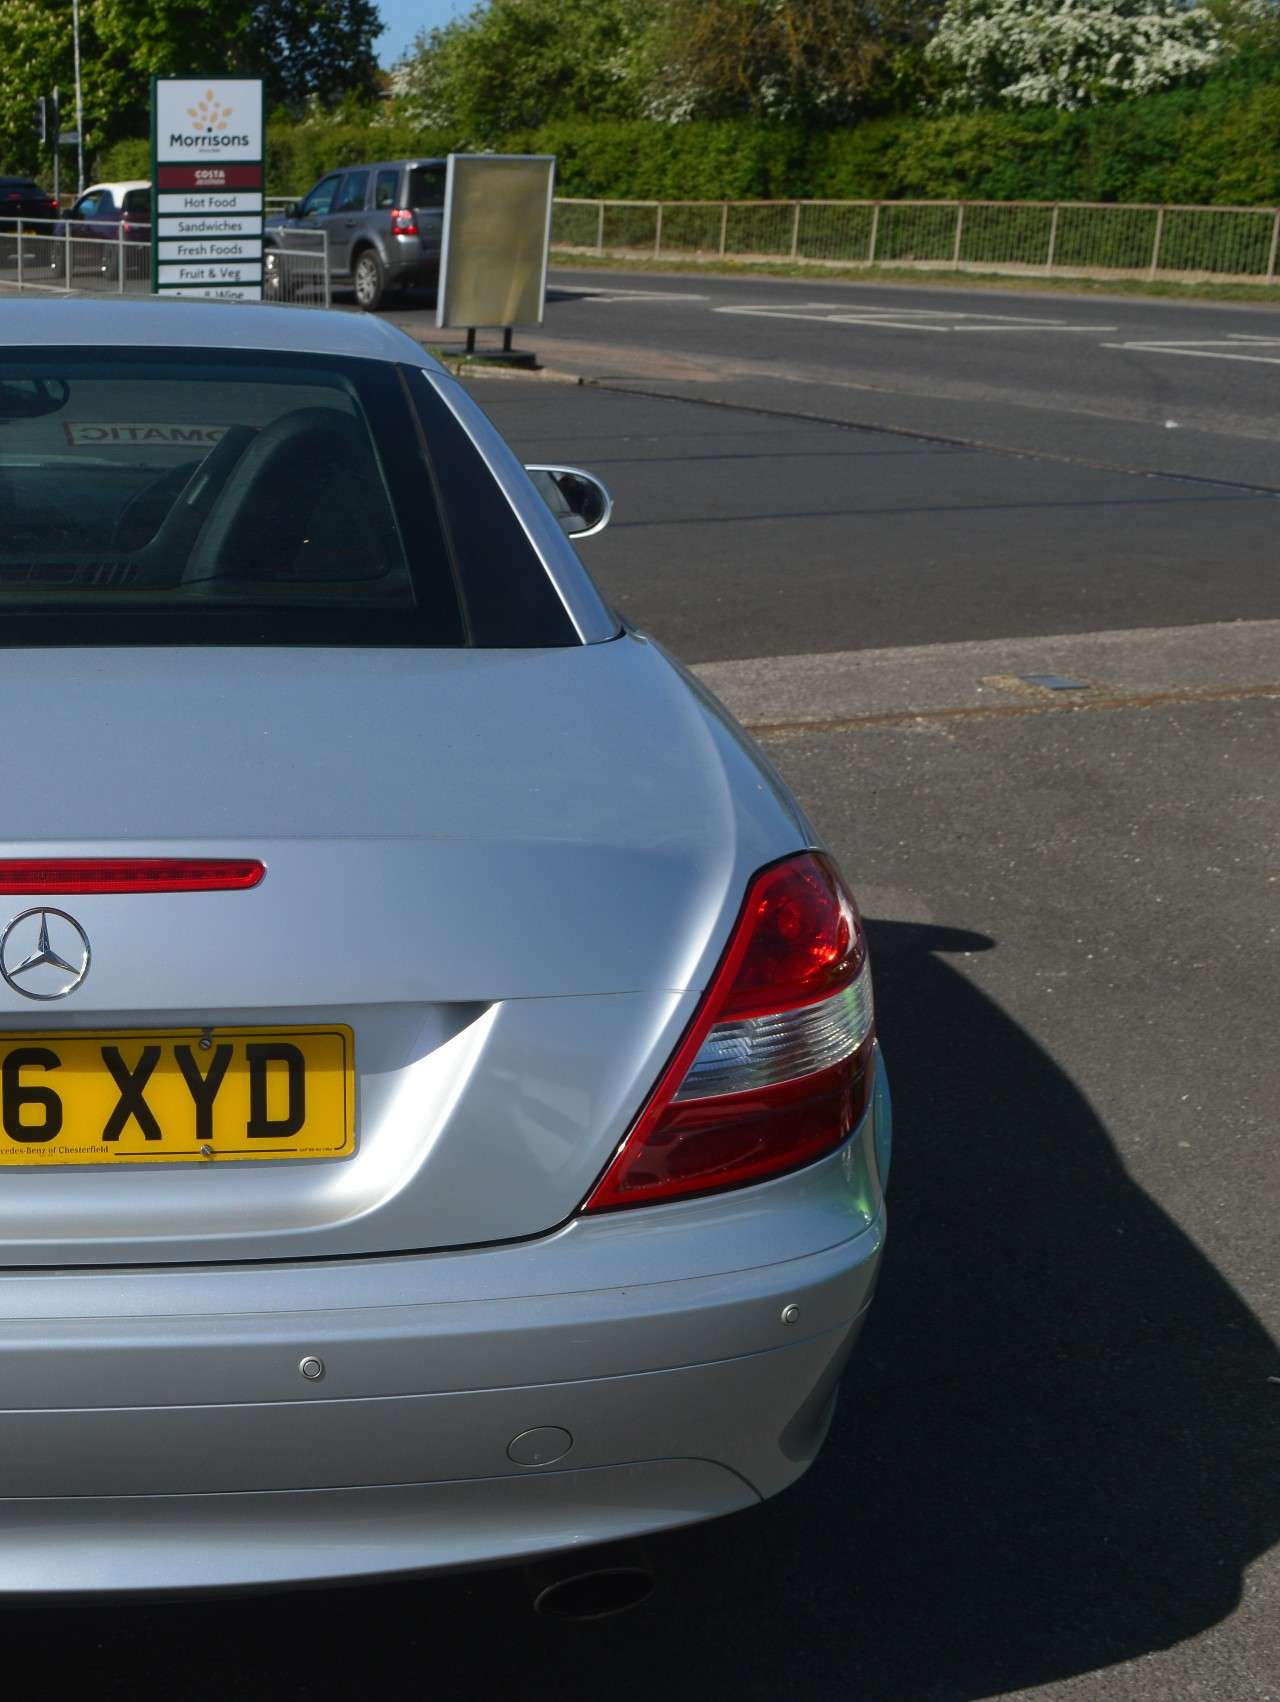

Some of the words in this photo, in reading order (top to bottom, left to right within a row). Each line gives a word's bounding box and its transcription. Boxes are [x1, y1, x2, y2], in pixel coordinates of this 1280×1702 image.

[170, 129, 249, 147] Morrisons
[195, 169, 225, 178] COSTA
[184, 197, 205, 208] Hot
[209, 196, 236, 208] Food
[178, 219, 242, 232] Sandwiches
[177, 244, 207, 255] Fresh
[210, 243, 242, 255] Foods
[179, 268, 204, 279] Fruit
[208, 268, 216, 279] &
[220, 267, 241, 282] Veg
[102, 1042, 307, 1142] XYD
[49, 1146, 56, 1154] of
[58, 1145, 109, 1154] Chesterfield
